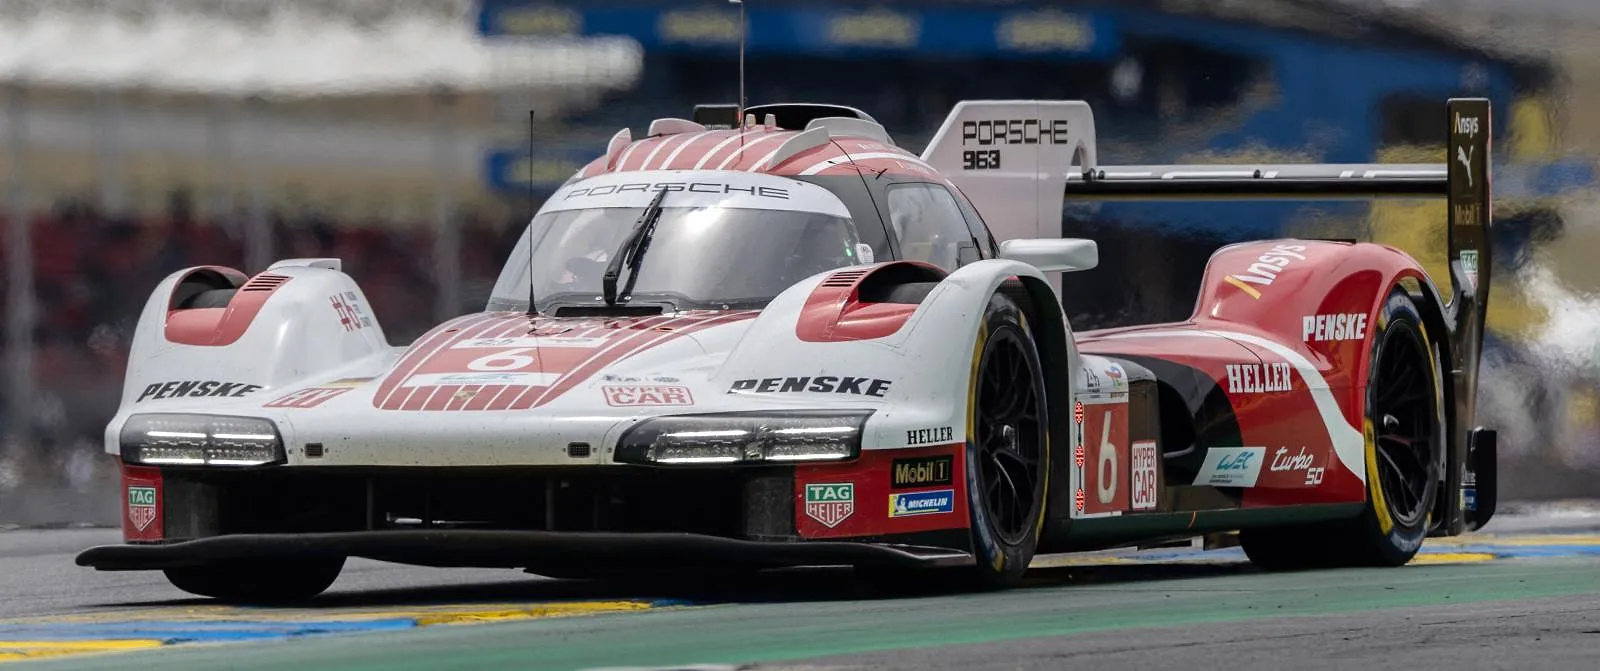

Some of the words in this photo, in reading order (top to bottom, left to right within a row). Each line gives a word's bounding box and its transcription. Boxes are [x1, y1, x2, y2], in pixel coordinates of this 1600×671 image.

[963, 119, 1067, 145] PORSCHE
[1454, 112, 1479, 138] Ansys
[963, 150, 1000, 169] 963
[564, 182, 789, 200] PORSCHE
[1454, 204, 1475, 225] Mobil
[1224, 244, 1306, 299] Ansys
[1303, 313, 1367, 341] PENSKE
[467, 347, 536, 371] 6
[727, 376, 892, 397] PENSKE
[1226, 362, 1292, 393] HELLER
[136, 381, 262, 403] PENSKE
[613, 393, 686, 404] CAR
[907, 427, 953, 445] HELLER
[1098, 411, 1117, 504] 6
[1133, 447, 1155, 469] HYPER
[1270, 446, 1314, 471] turbo
[895, 461, 934, 485] Mobil
[130, 489, 153, 504] TAG
[810, 486, 850, 499] TAG
[1133, 470, 1155, 503] CAR
[808, 503, 851, 524] HEUER
[908, 497, 947, 508] MICHELIN
[130, 507, 154, 526] HEUER
